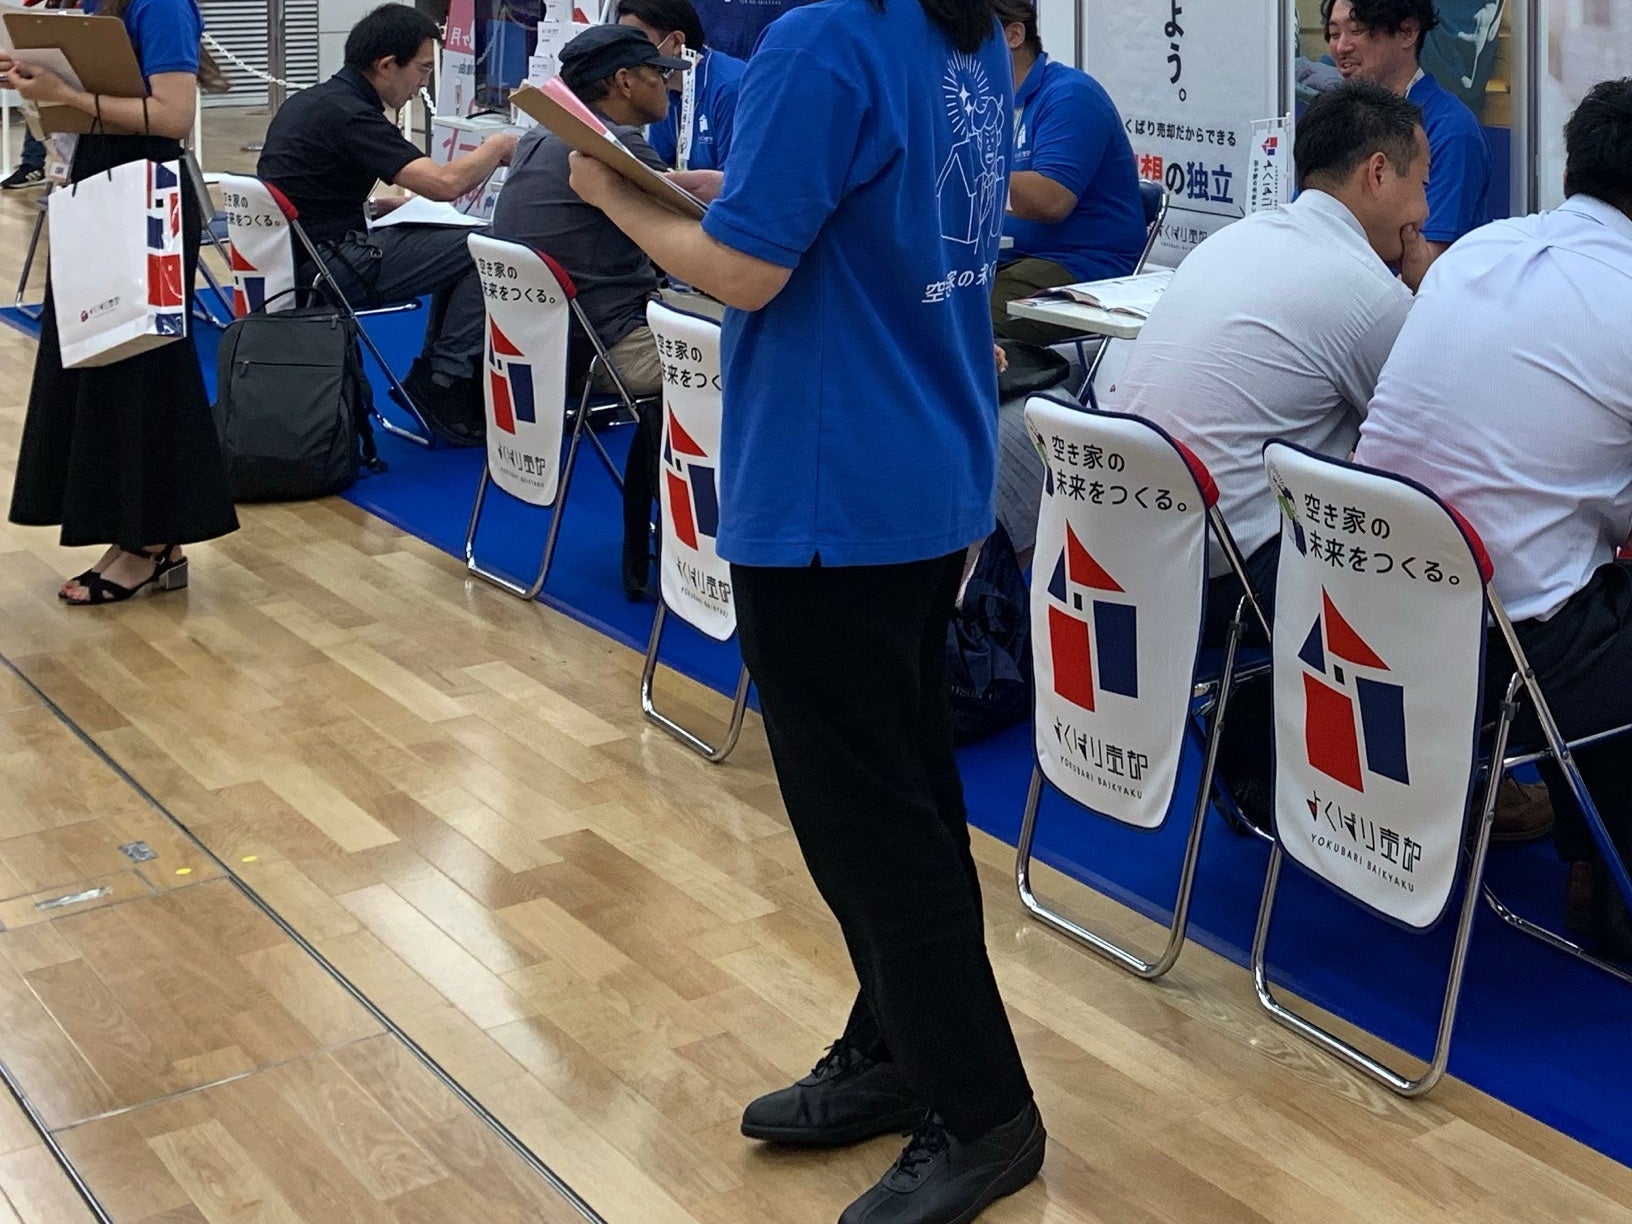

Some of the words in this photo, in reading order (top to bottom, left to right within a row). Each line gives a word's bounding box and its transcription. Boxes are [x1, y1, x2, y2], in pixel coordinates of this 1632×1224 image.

[1052, 435, 1125, 472] 空き家の
[1056, 468, 1187, 512] 未来をつくる。
[1304, 493, 1391, 539] 空き家の
[1309, 530, 1460, 585] 未来をつくる。
[1054, 716, 1149, 781] よくばり売却
[1060, 755, 1094, 782] YOKUBARI
[1097, 776, 1143, 800] BAIKYAKU
[1306, 790, 1422, 874] よくばり売却
[1311, 833, 1363, 865] YOKUBARI
[1366, 860, 1415, 893] BAIKYAKU
